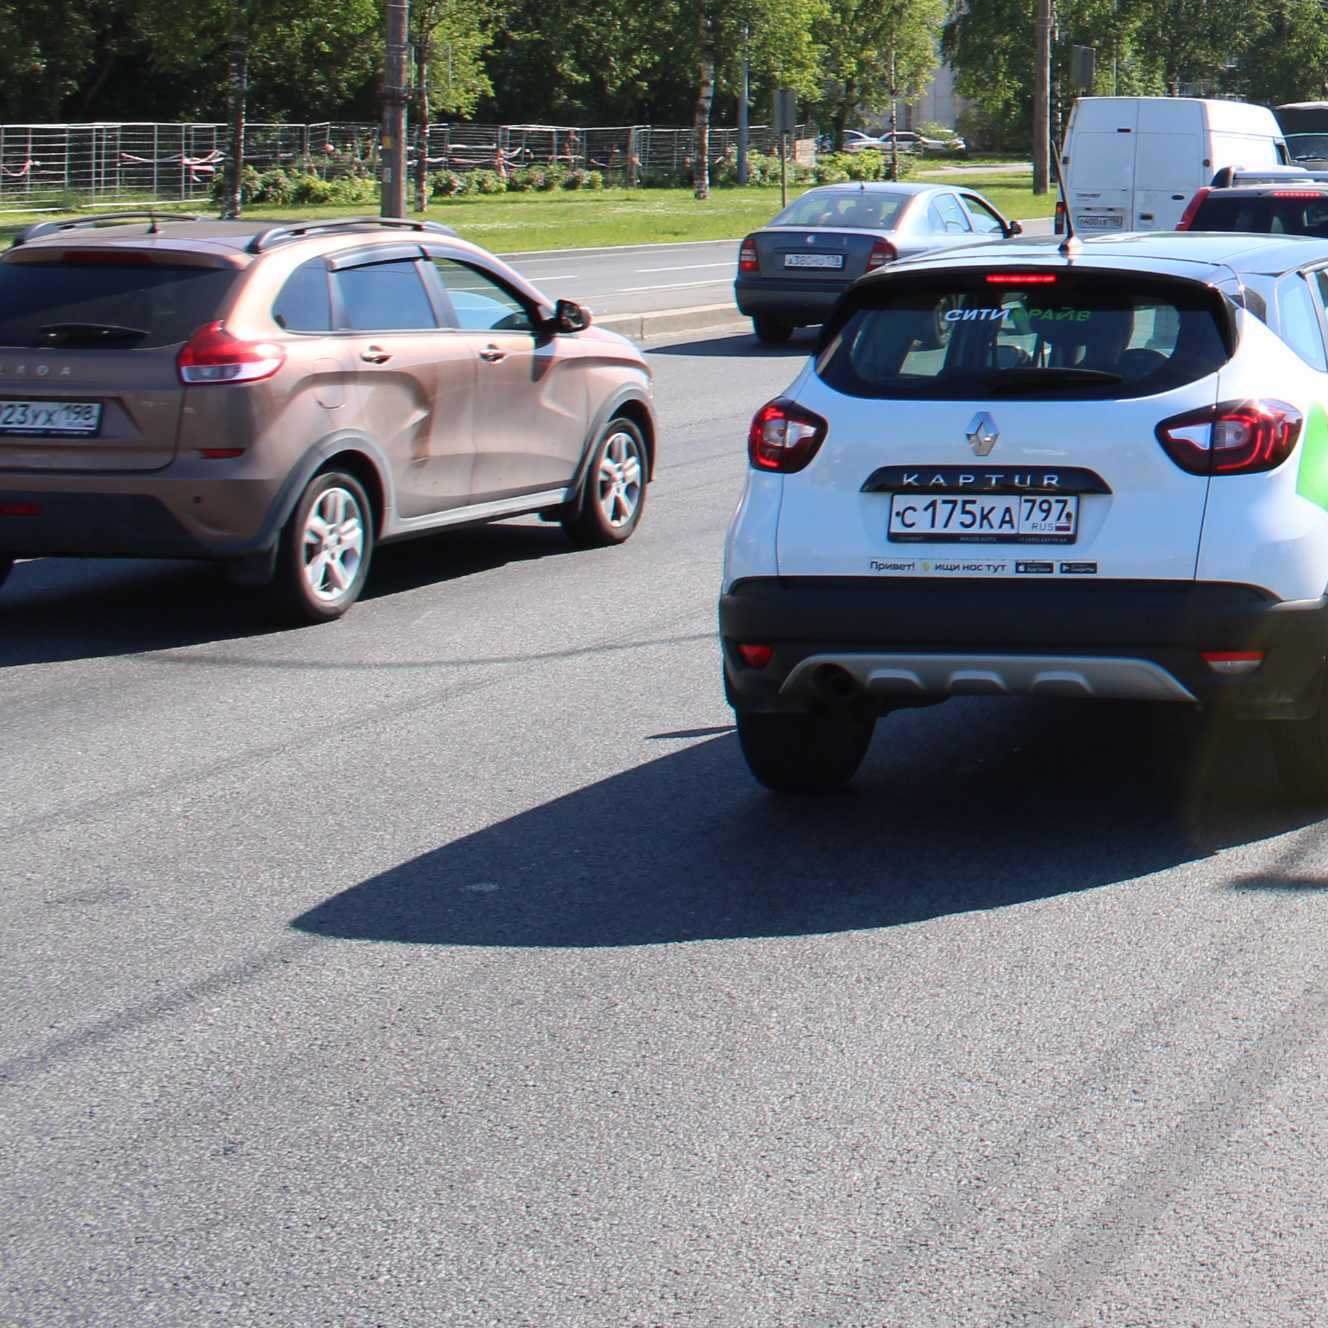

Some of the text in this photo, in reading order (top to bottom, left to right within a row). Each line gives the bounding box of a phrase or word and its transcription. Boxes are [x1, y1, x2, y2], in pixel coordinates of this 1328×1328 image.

[903, 473, 1060, 488] KAPTUR
[1023, 499, 1070, 522] 797
[1032, 522, 1054, 532] RUS
[870, 560, 916, 572] Привет!
[934, 562, 960, 573] ищи
[986, 562, 1007, 573] тут
